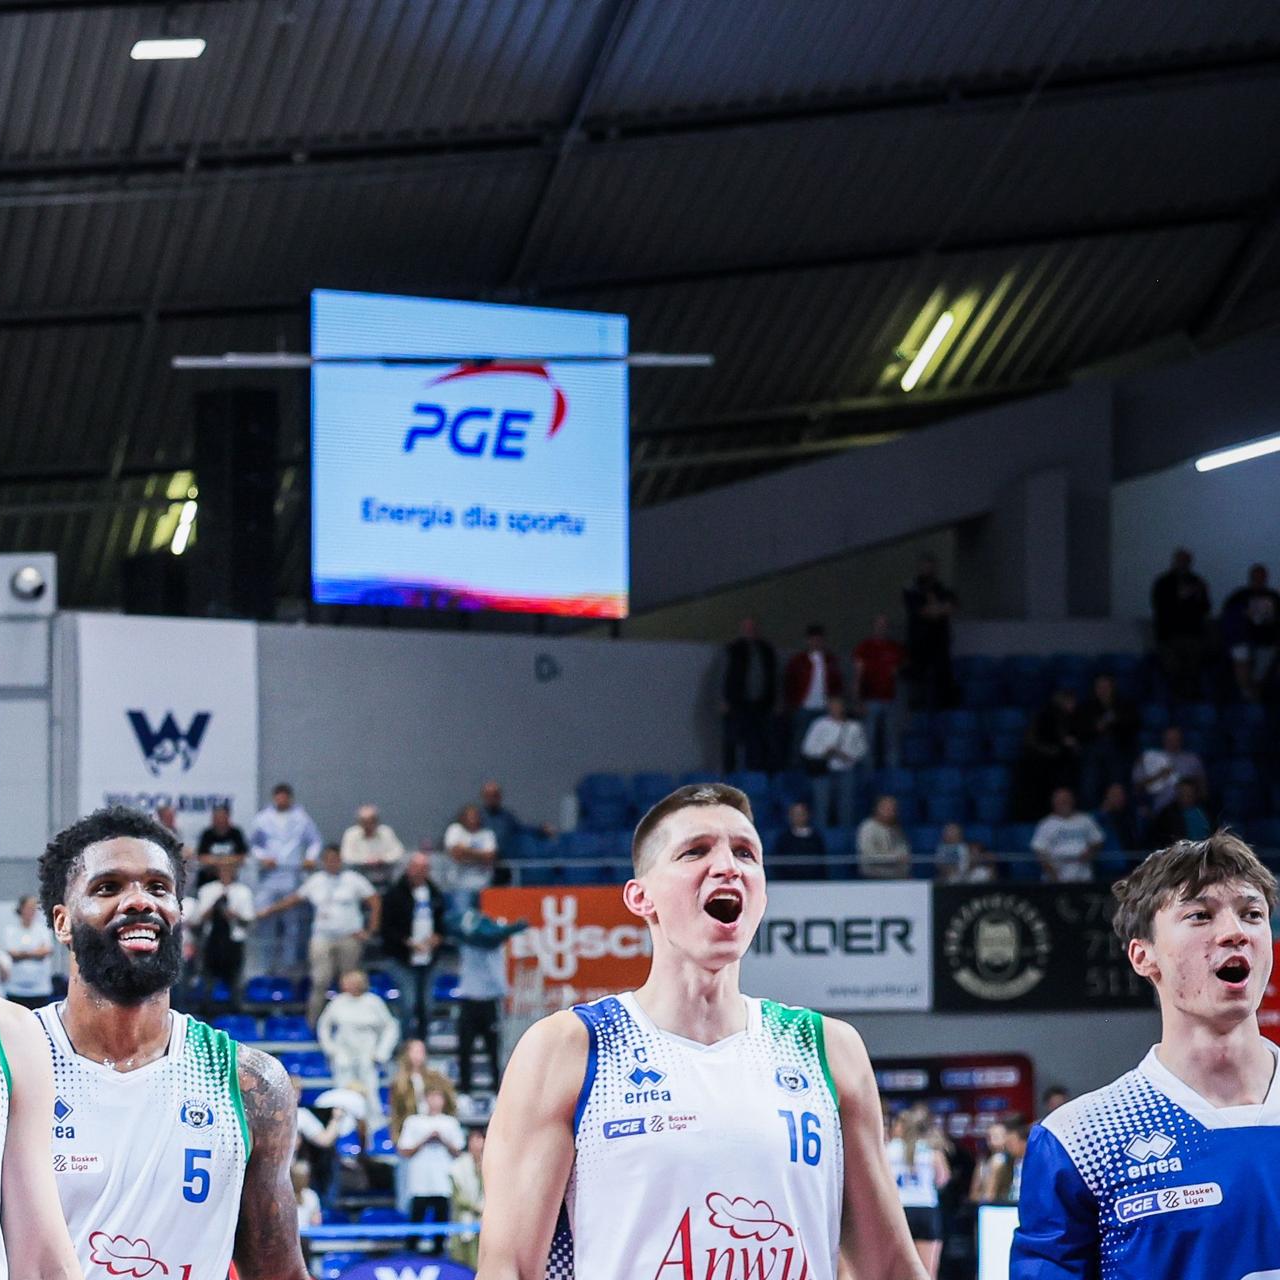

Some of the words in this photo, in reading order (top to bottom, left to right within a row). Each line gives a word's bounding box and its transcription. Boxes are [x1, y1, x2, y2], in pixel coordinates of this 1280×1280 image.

[403, 402, 534, 459] PGE
[361, 498, 453, 531] Energia
[462, 506, 497, 530] dla
[507, 510, 586, 537] sportu
[624, 1089, 671, 1105] errea
[608, 1122, 642, 1137] PGE
[668, 1113, 698, 1123] Basket
[668, 1122, 688, 1131] Liga
[778, 1108, 822, 1167] 16
[70, 1154, 98, 1164] Basket
[70, 1163, 88, 1172] Liga
[1127, 1155, 1183, 1180] errea
[182, 1148, 211, 1204] 5
[1122, 1197, 1154, 1216] PGE
[1182, 1185, 1215, 1198] Basket
[1184, 1195, 1205, 1207] Liga
